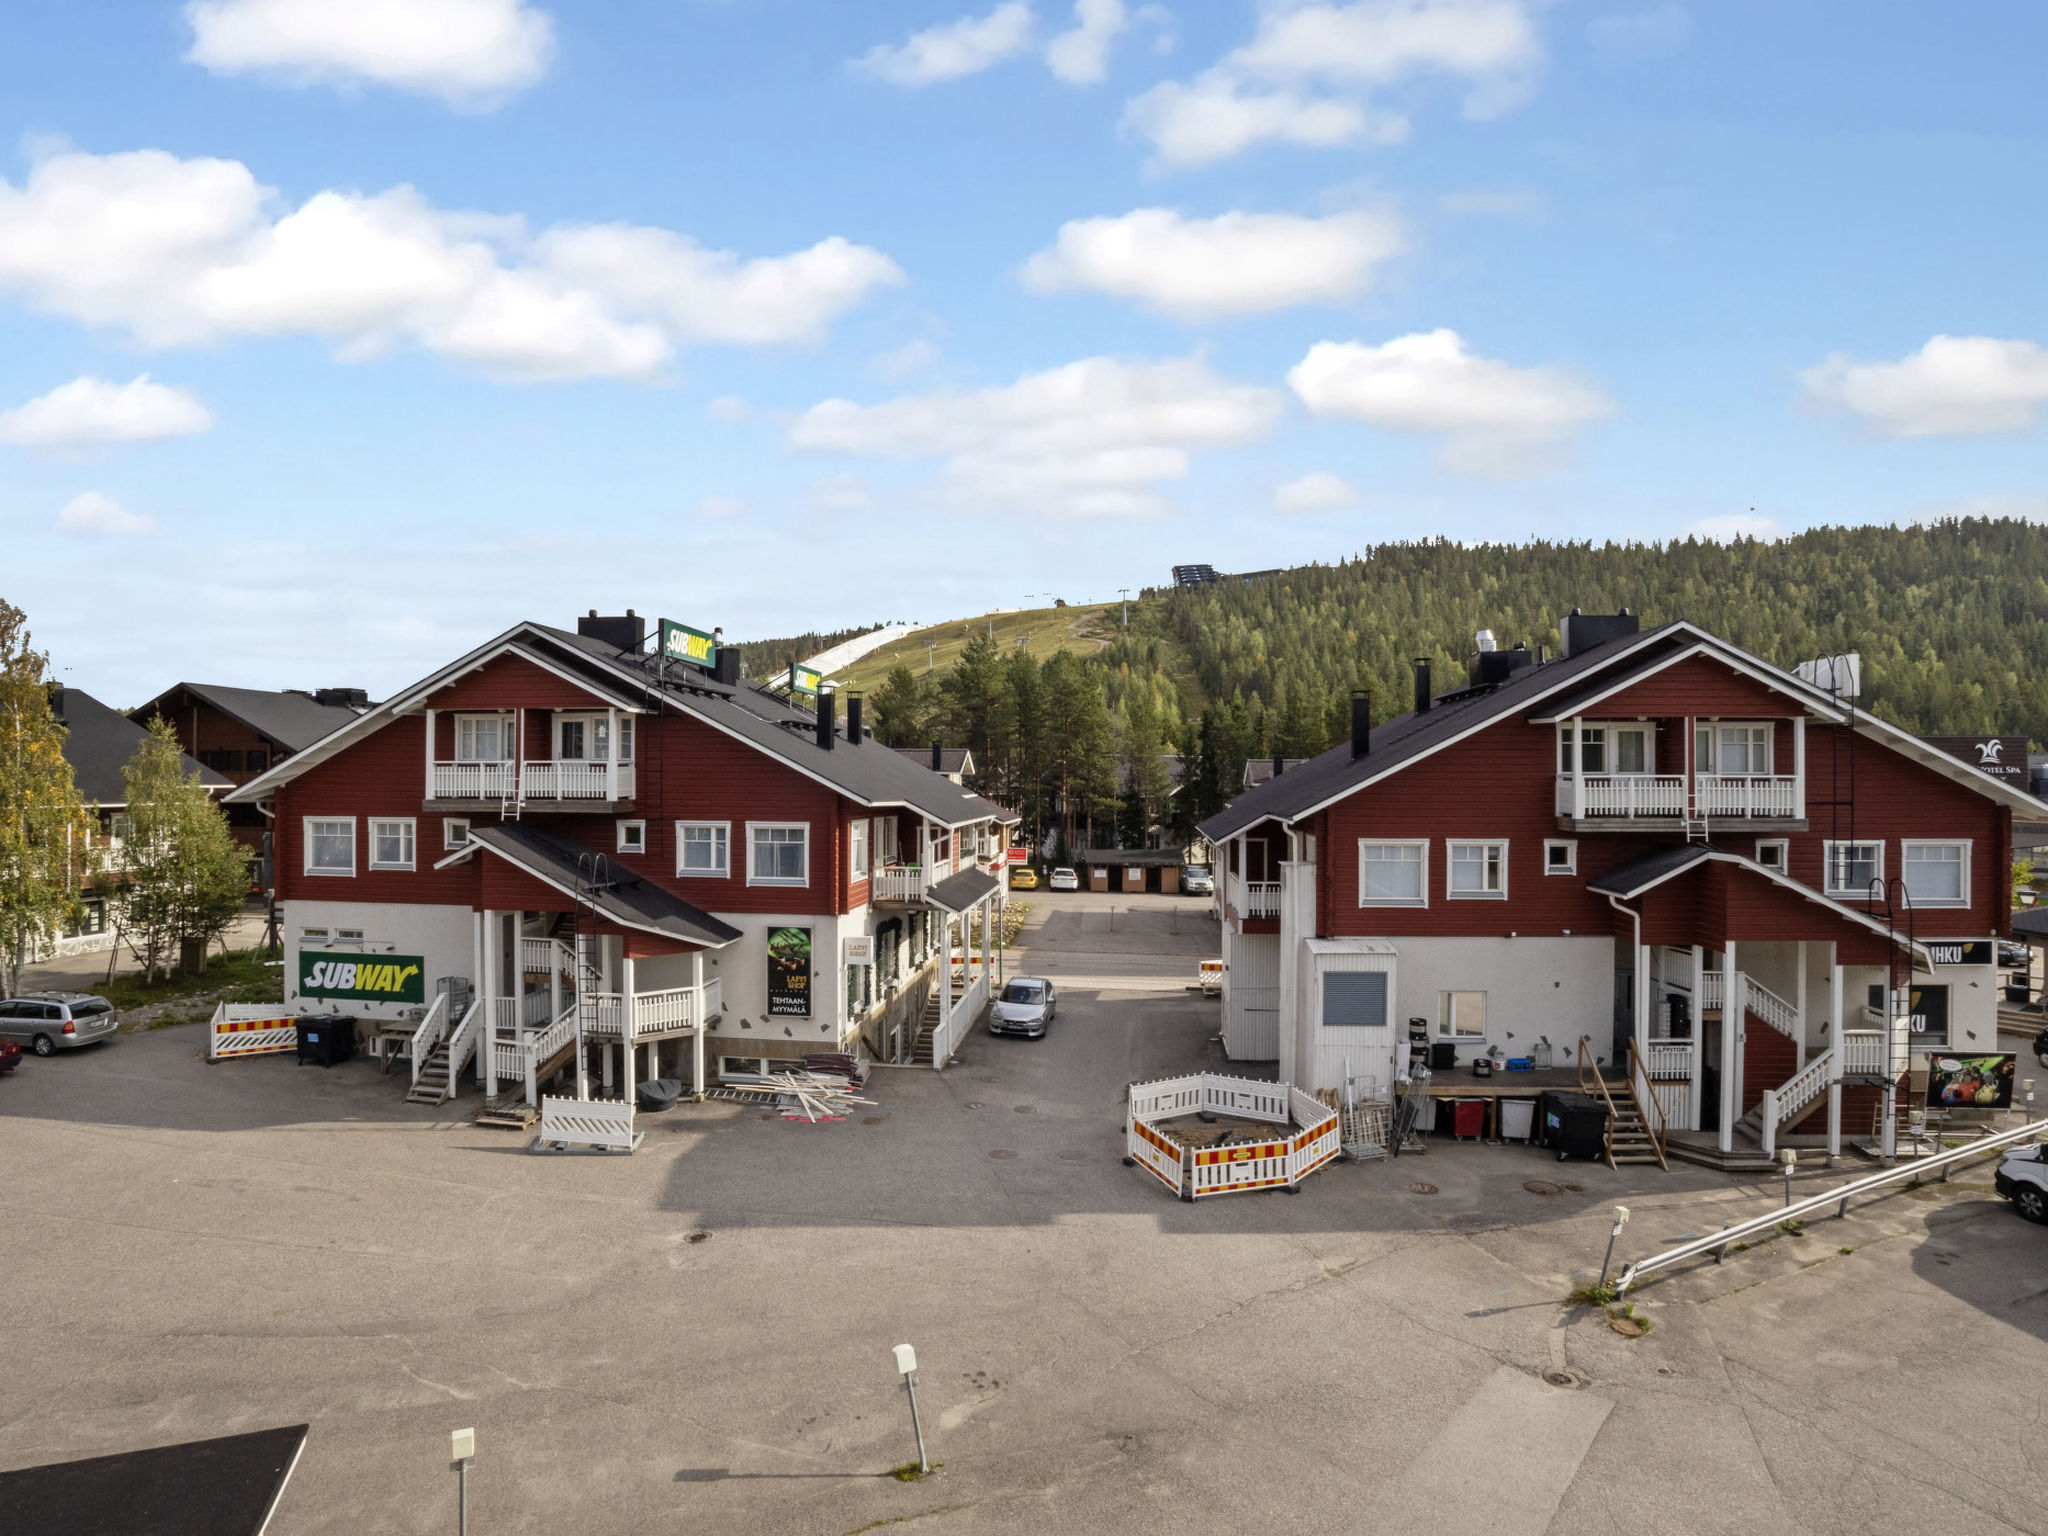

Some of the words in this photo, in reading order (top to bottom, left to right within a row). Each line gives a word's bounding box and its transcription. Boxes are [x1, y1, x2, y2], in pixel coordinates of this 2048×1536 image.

[666, 628, 712, 660] SUBWAY
[303, 961, 420, 992] SUBWAY
[772, 1005, 807, 1014] MYYMÄLÄ
